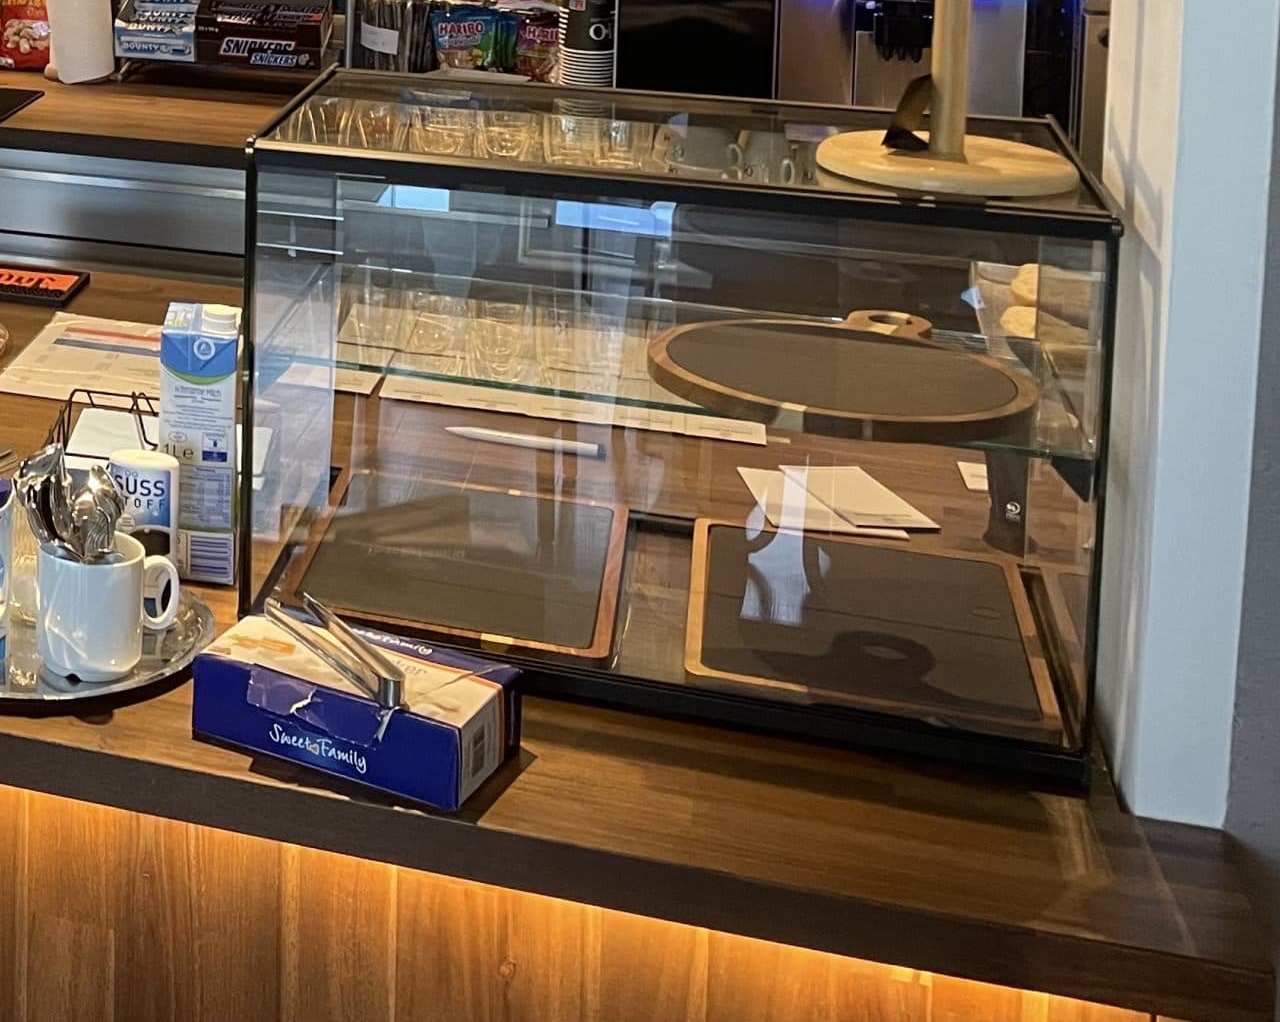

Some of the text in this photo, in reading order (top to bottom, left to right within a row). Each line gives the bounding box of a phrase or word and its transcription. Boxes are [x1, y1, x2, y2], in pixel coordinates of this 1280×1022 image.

[439, 21, 485, 35] HARIBO
[122, 42, 159, 51] BOUNTY
[222, 39, 294, 55] SNICKERS
[252, 54, 296, 66] SNICKERS
[114, 472, 166, 497] SÜSS
